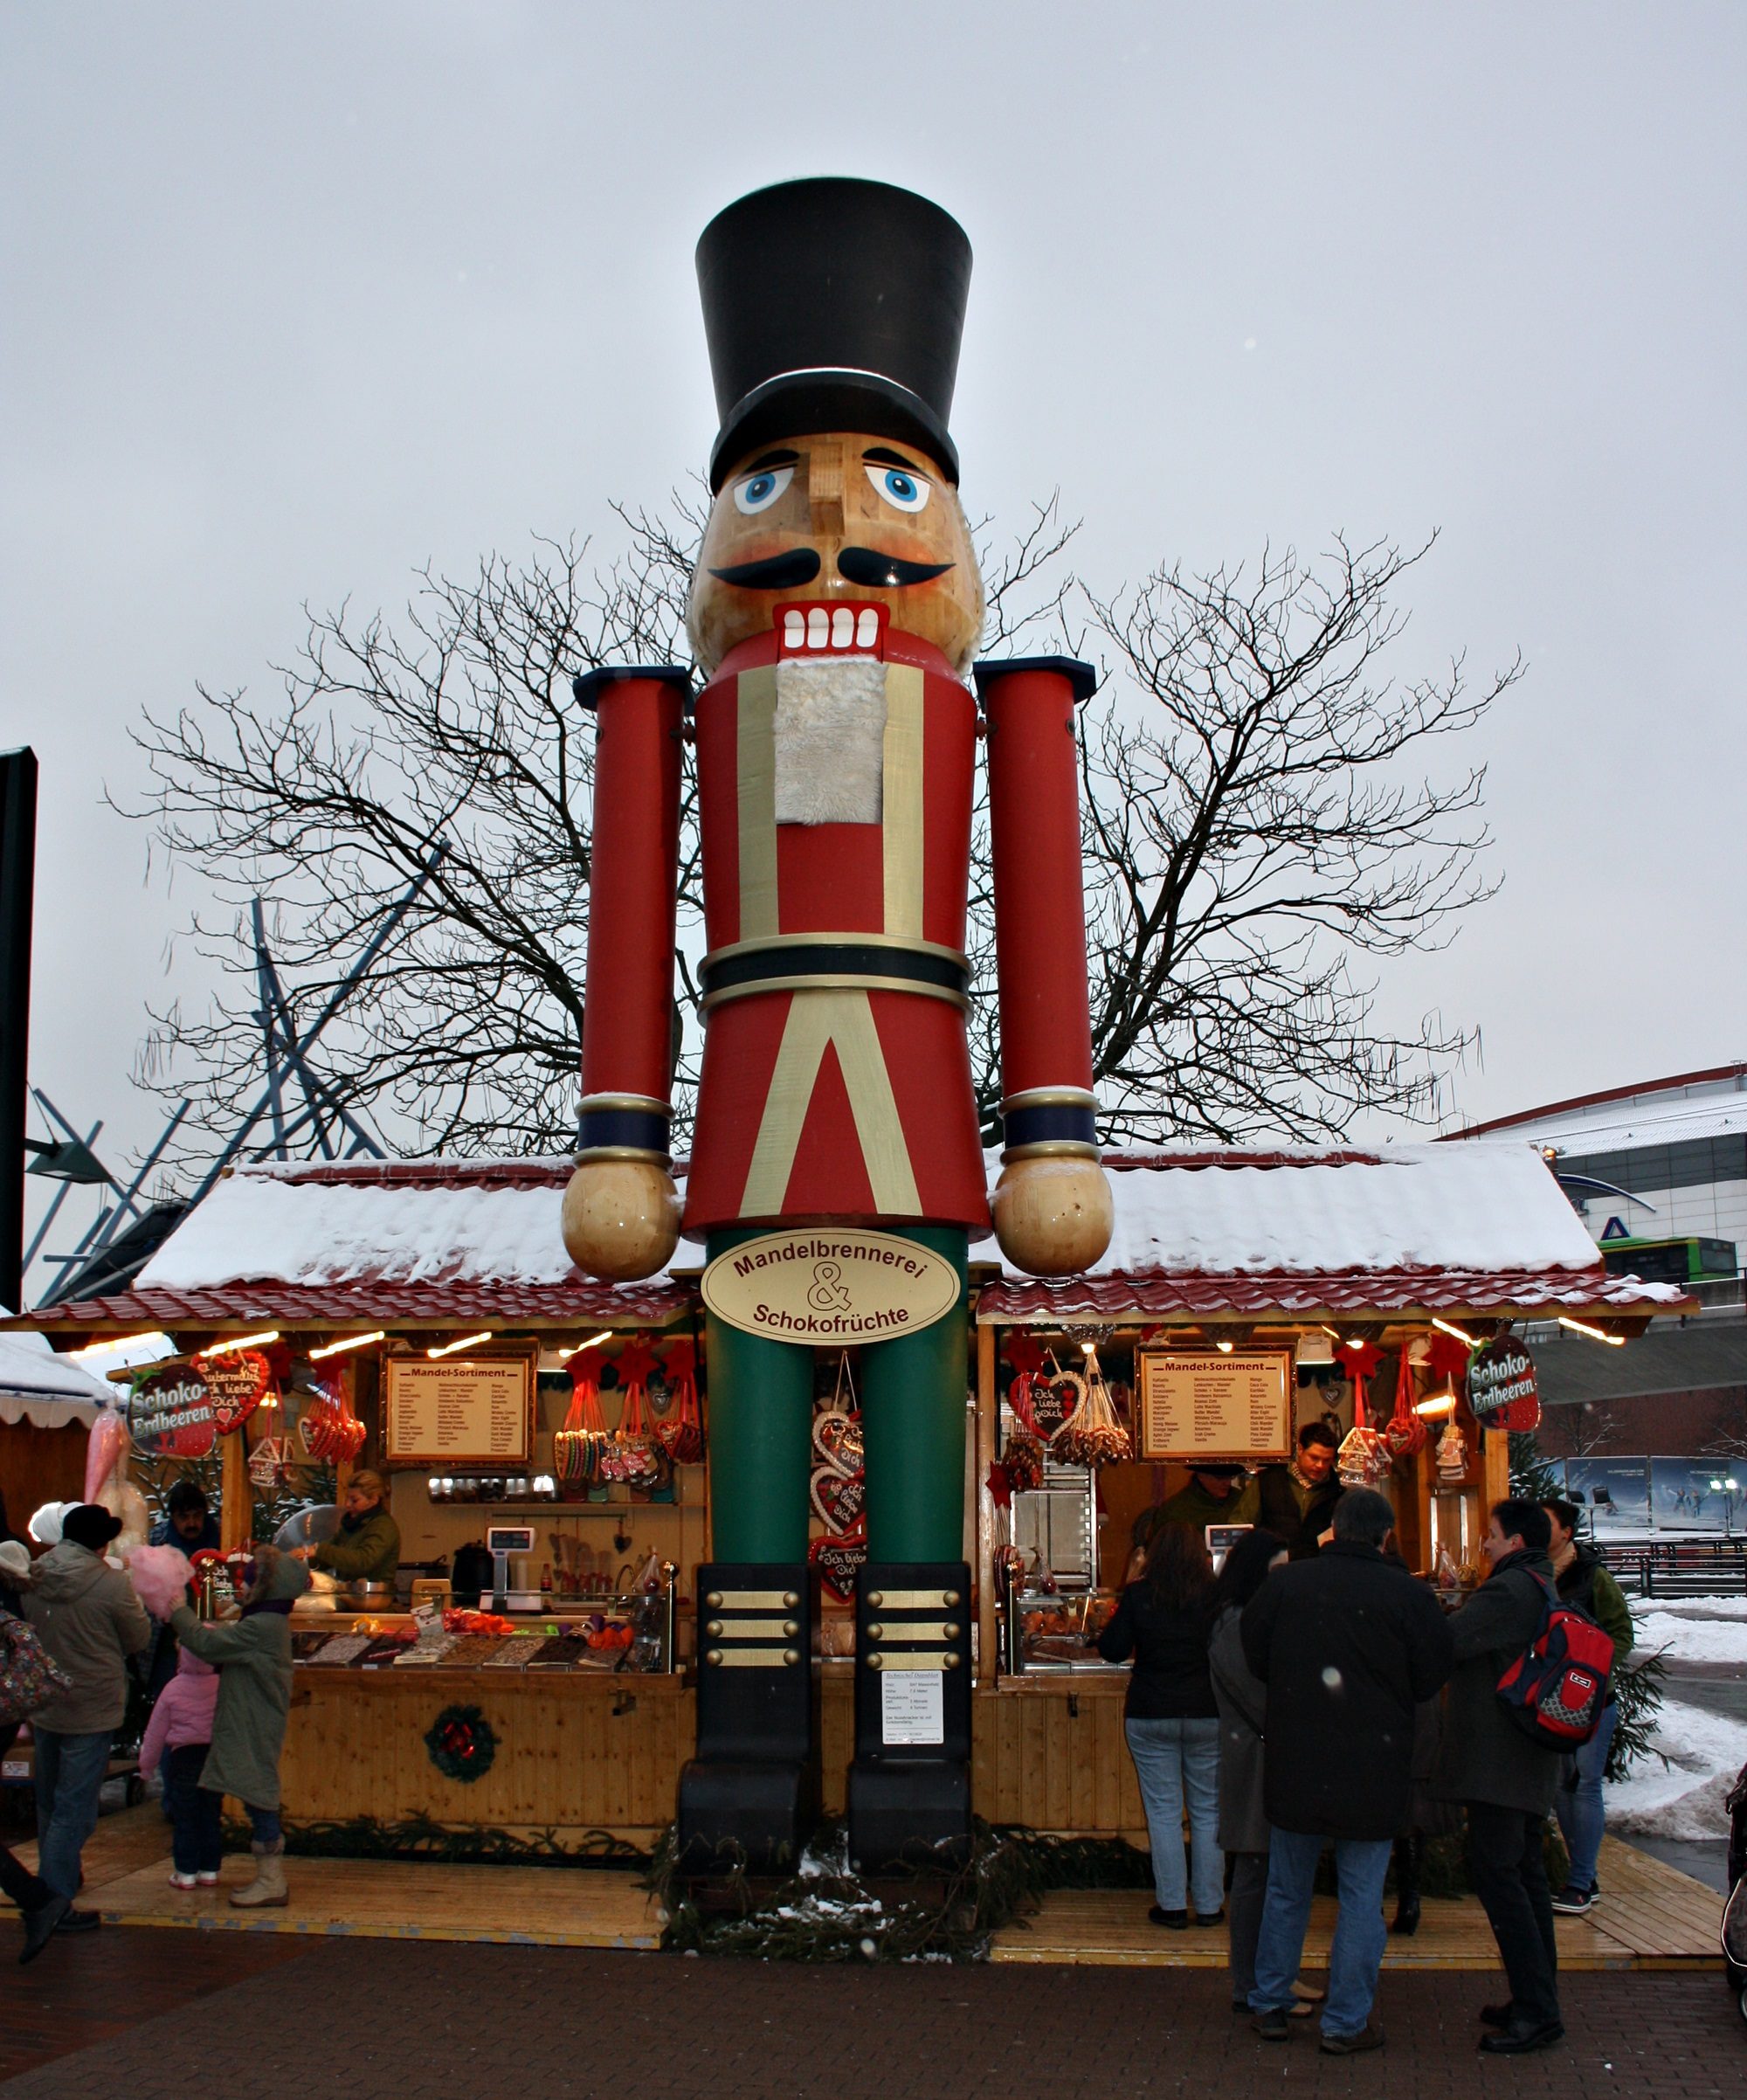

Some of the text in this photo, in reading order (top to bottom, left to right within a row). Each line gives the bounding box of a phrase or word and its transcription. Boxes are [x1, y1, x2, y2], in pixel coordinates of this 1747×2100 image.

[733, 1240, 928, 1279] Mandelbrennerei
[807, 1261, 853, 1311] &
[753, 1303, 909, 1333] Schokofrüchte
[411, 1368, 507, 1377] Mandel-Sortiment
[1165, 1362, 1265, 1371] Mandel-Sortiment
[1470, 1352, 1530, 1388] Schoko-
[131, 1381, 208, 1413] Schoko-
[224, 1383, 252, 1394] liebe
[1034, 1388, 1055, 1399] Ich
[1472, 1378, 1535, 1413] Erdbeeren
[210, 1395, 239, 1407] Dich
[1038, 1399, 1062, 1408] liebe
[132, 1406, 211, 1439] Erdbeeren
[1041, 1407, 1064, 1419] Dich
[840, 1447, 860, 1468] Dich
[833, 1504, 851, 1523] Dich
[823, 1551, 844, 1565] Ich
